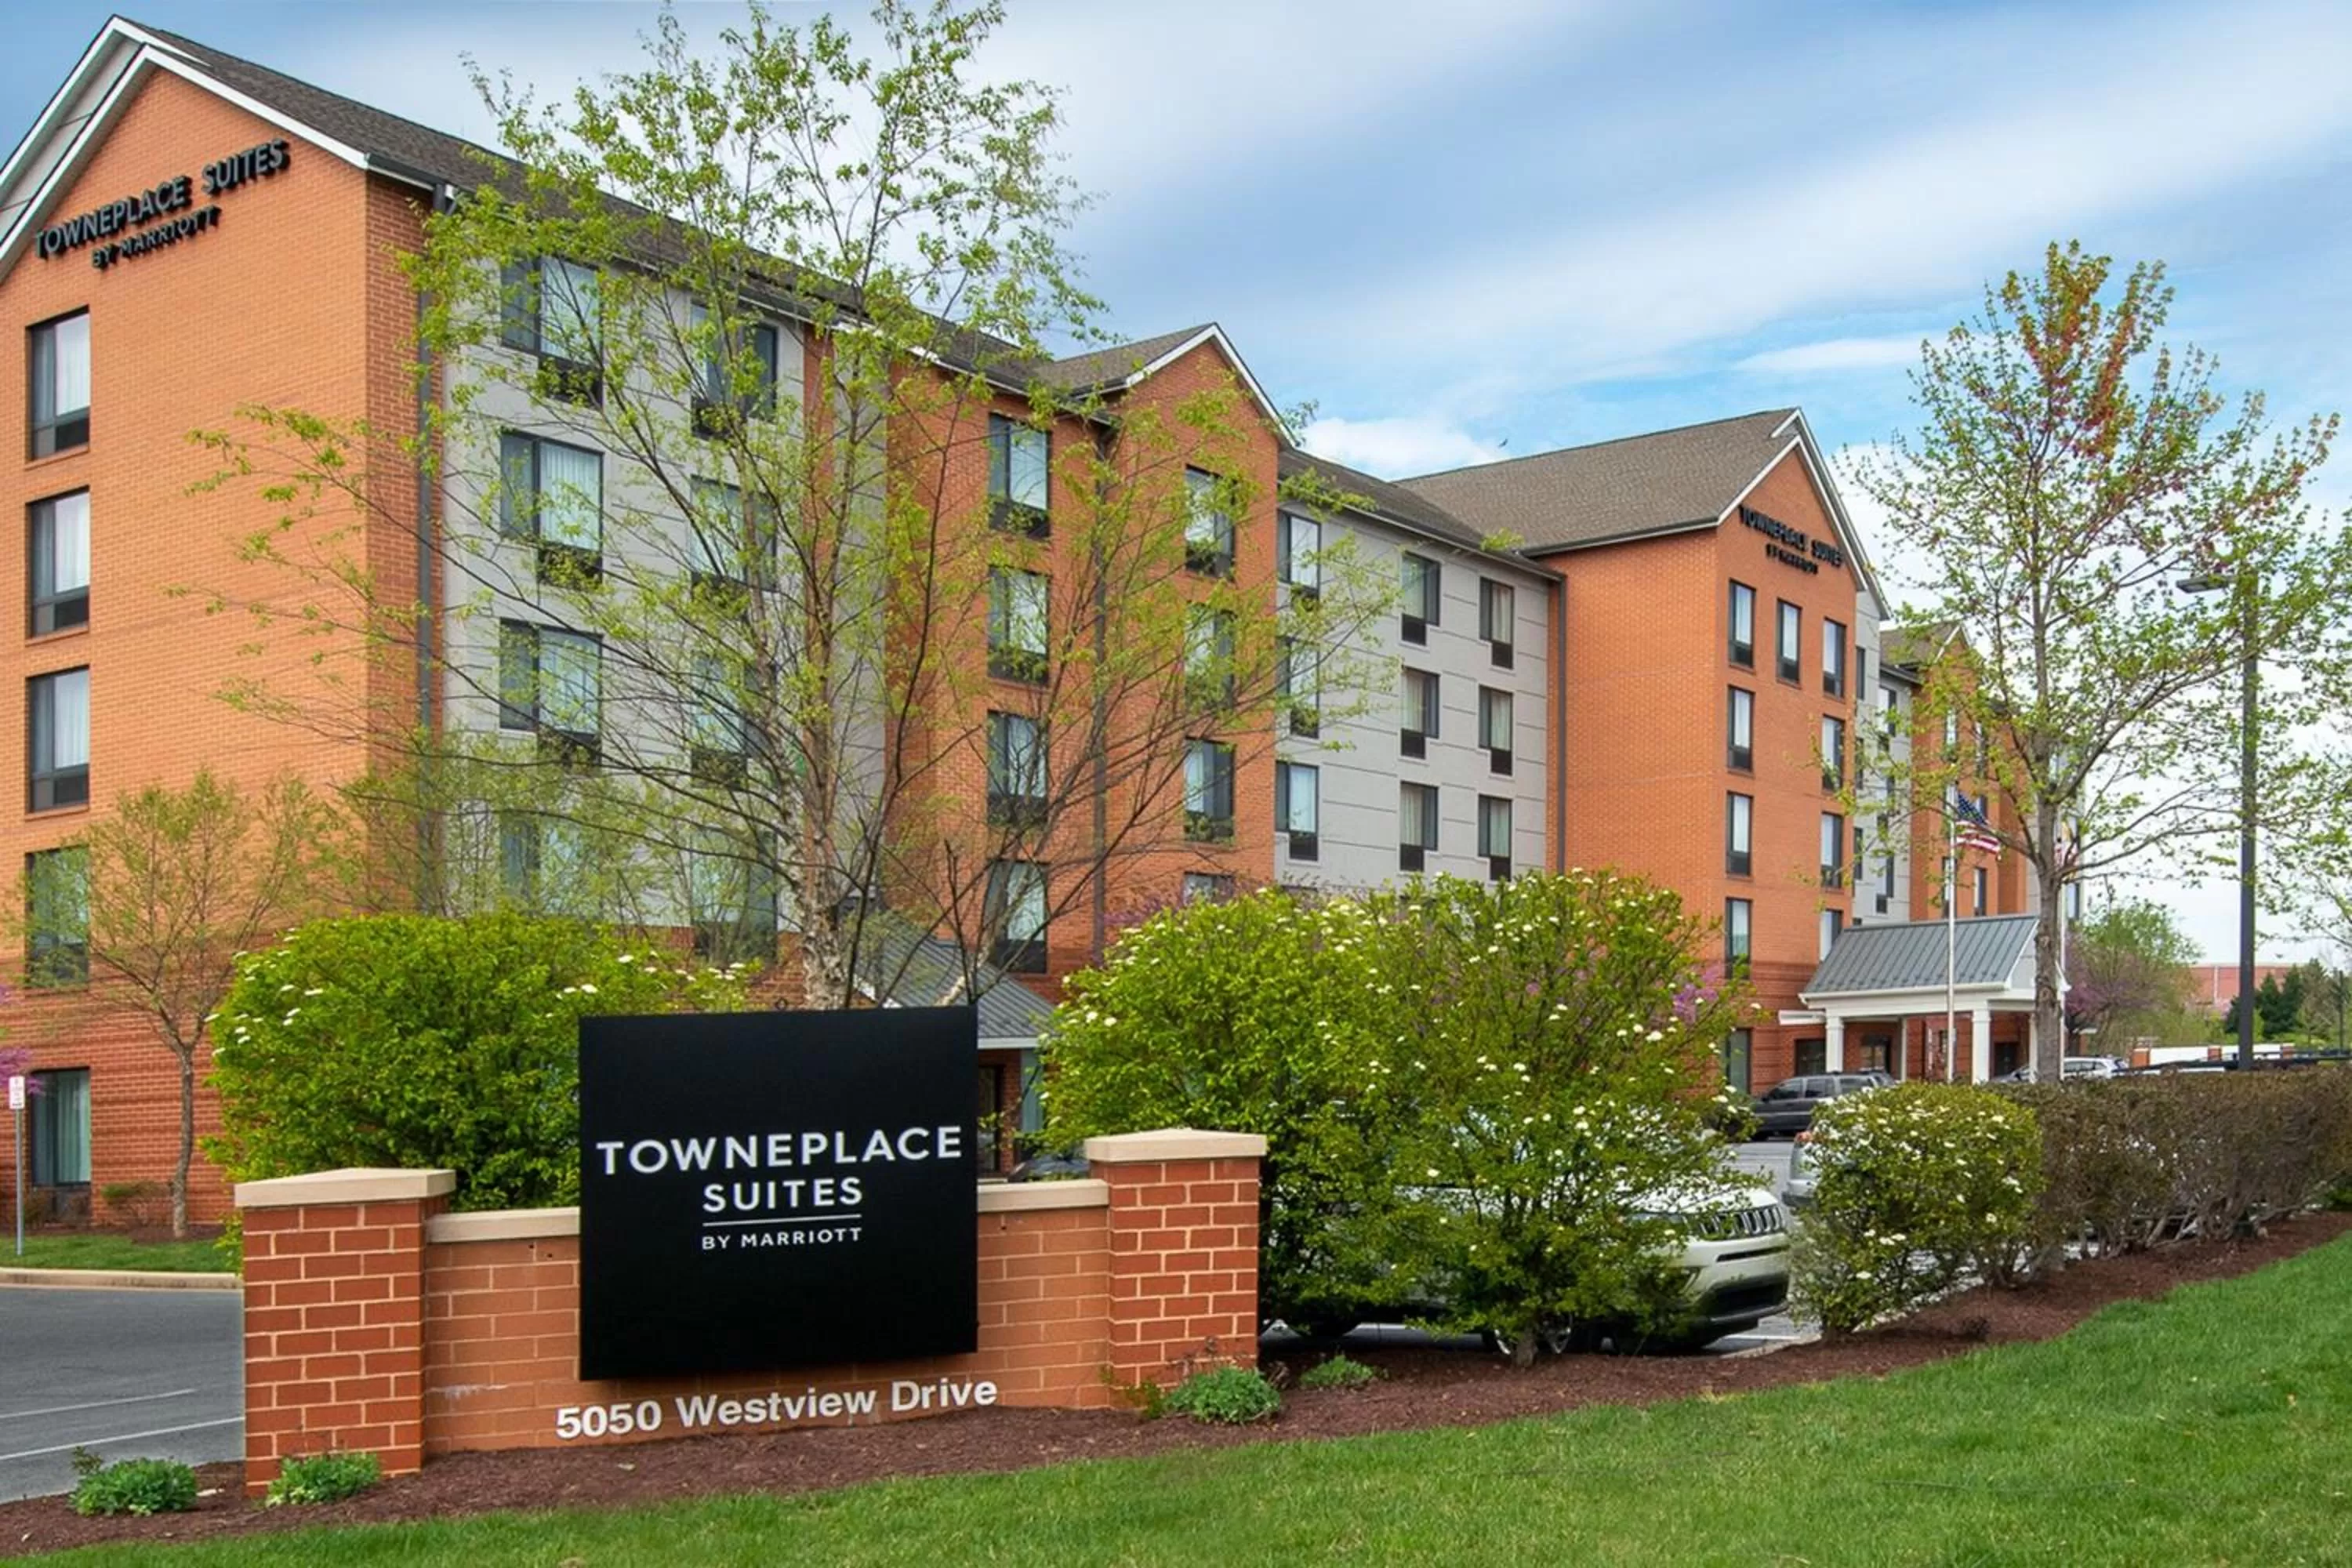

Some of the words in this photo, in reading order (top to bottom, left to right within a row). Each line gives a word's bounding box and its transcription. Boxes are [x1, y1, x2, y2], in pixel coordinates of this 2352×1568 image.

[36, 176, 193, 260] TOWNEPLACE
[201, 139, 291, 196] SUITES
[91, 245, 118, 270] BY
[118, 205, 223, 258] MARRIOTT
[597, 1126, 962, 1175] TOWNEPLACE
[702, 1177, 862, 1214] SUITES
[702, 1235, 731, 1250] BY
[740, 1227, 862, 1248] MARRIOTT
[556, 1399, 662, 1439] 5050
[675, 1387, 877, 1428] Westview
[891, 1377, 998, 1412] Drive
